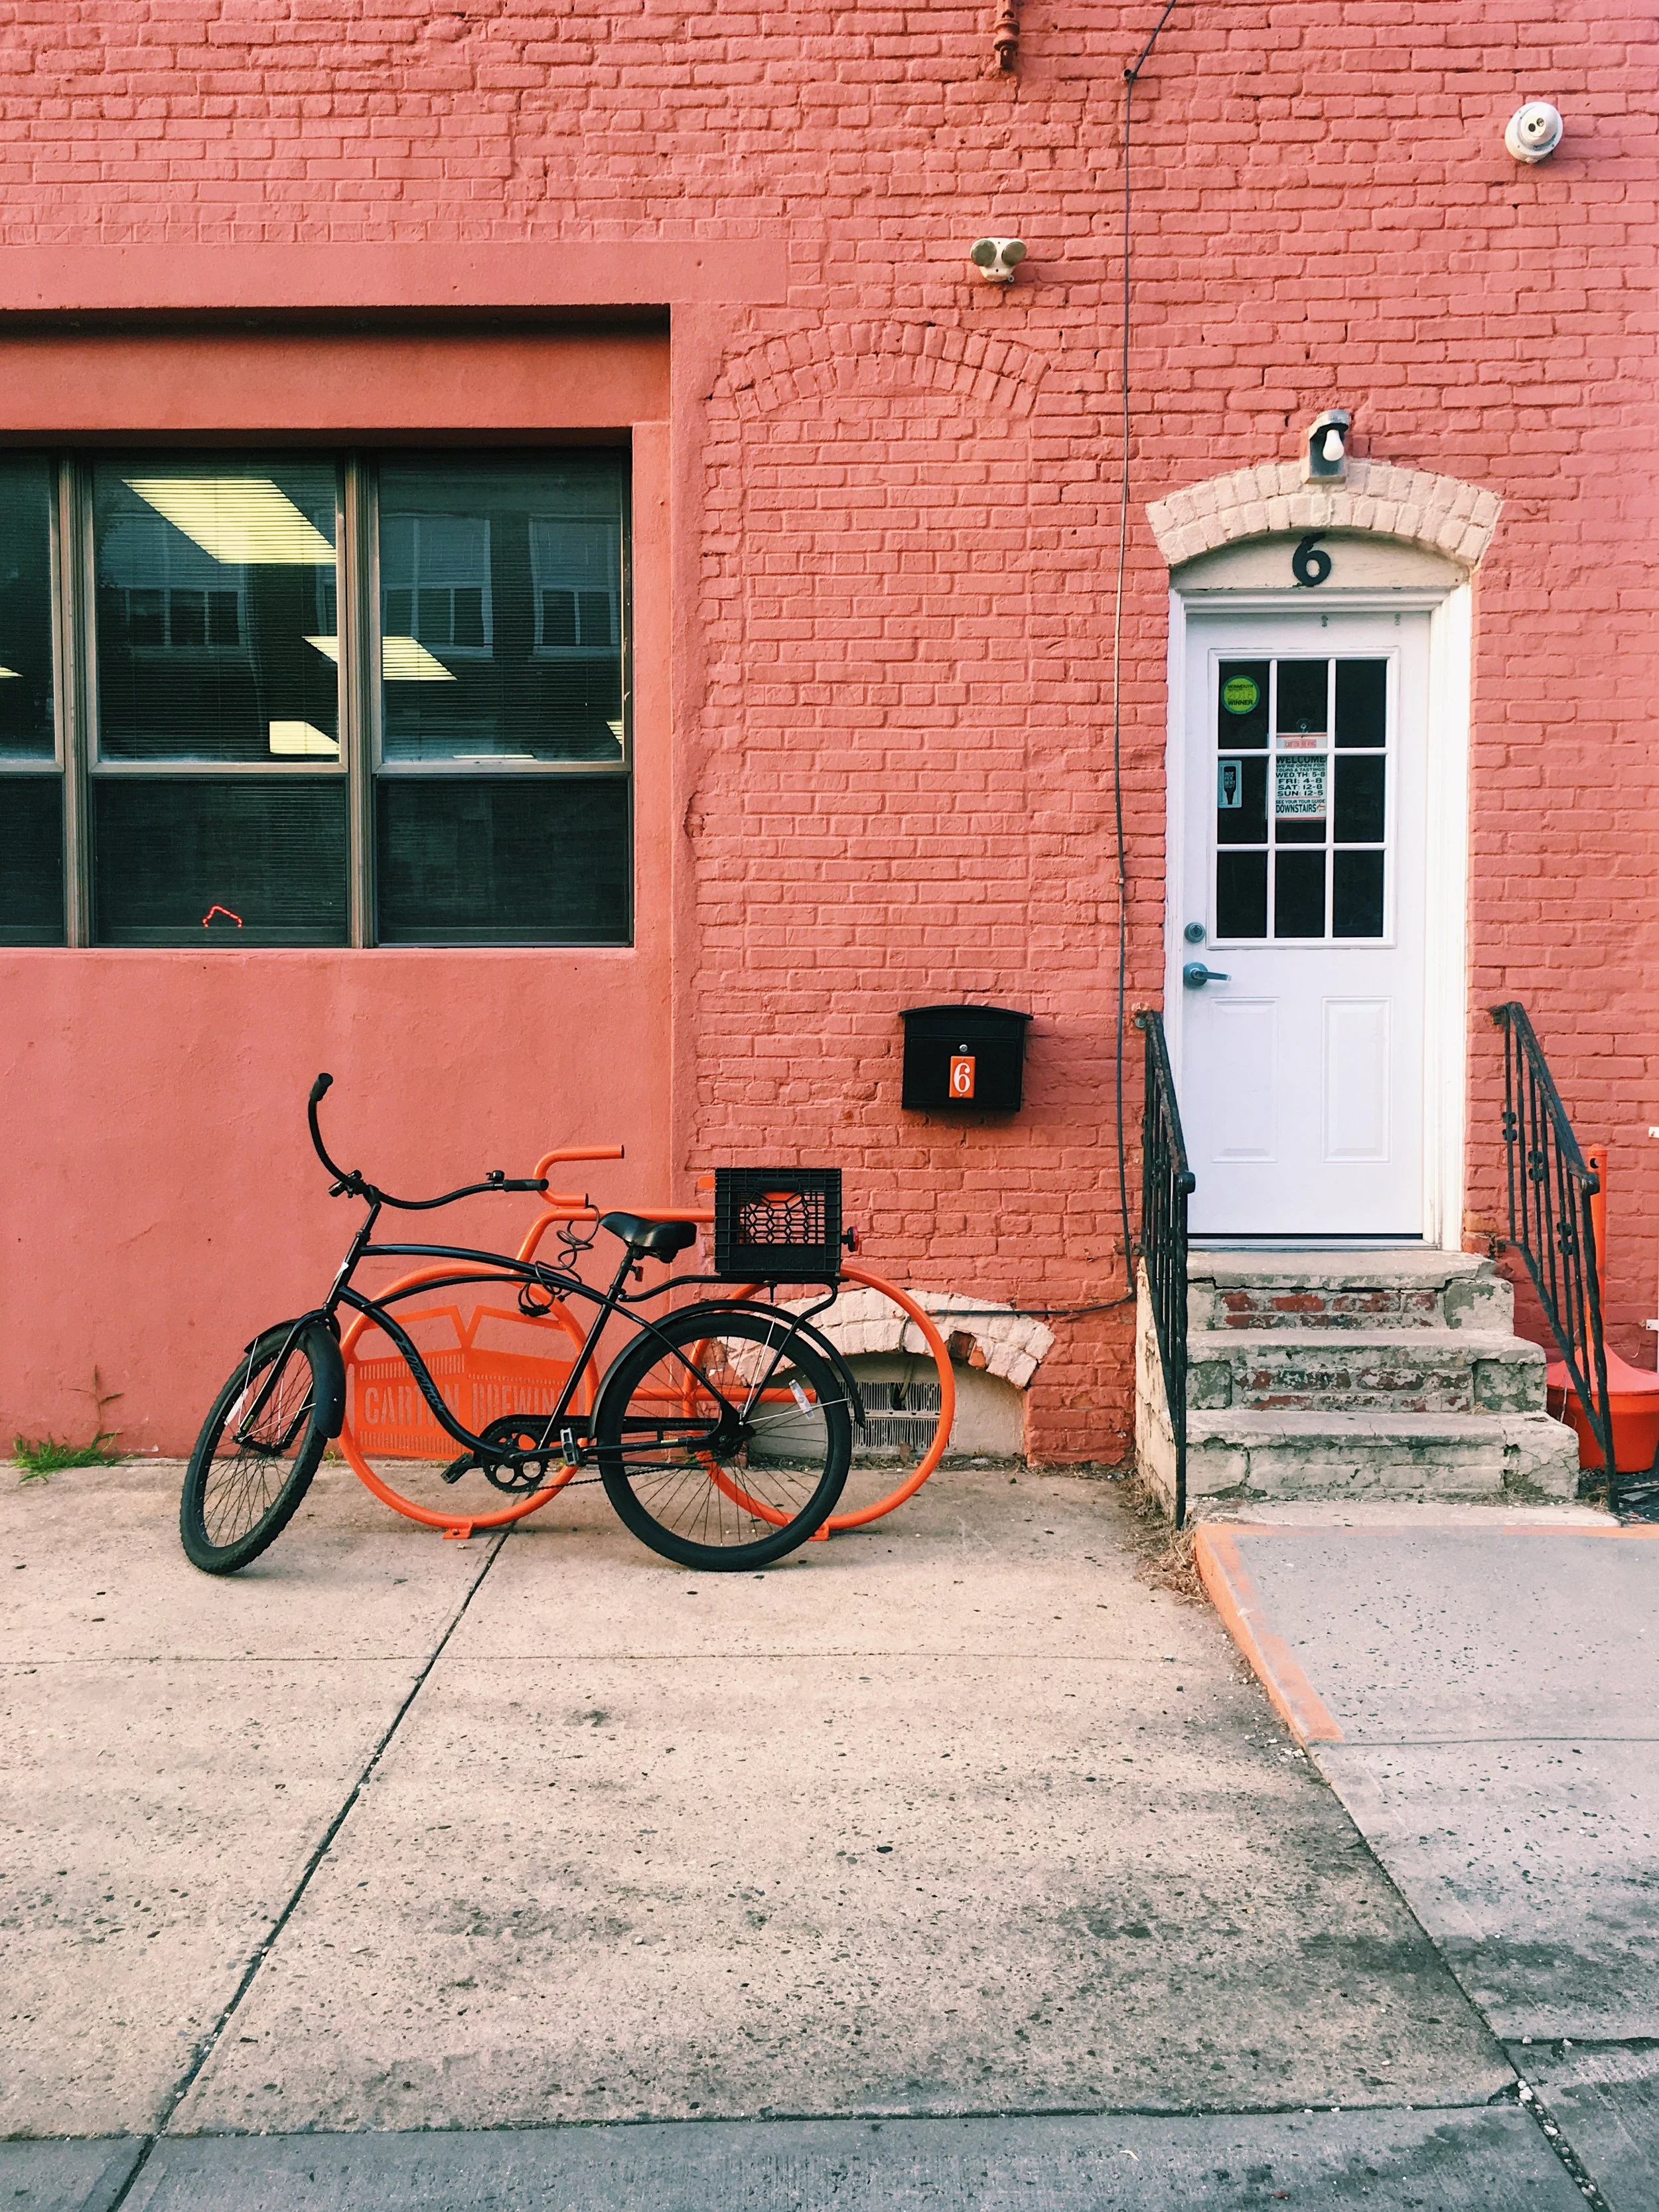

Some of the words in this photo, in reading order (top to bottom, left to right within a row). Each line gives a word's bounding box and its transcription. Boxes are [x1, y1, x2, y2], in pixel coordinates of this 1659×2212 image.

[1292, 532, 1331, 587] 6
[1275, 804, 1317, 813] DOWNSTAIRS
[954, 1063, 970, 1092] 6
[364, 1383, 460, 1428] CARTN
